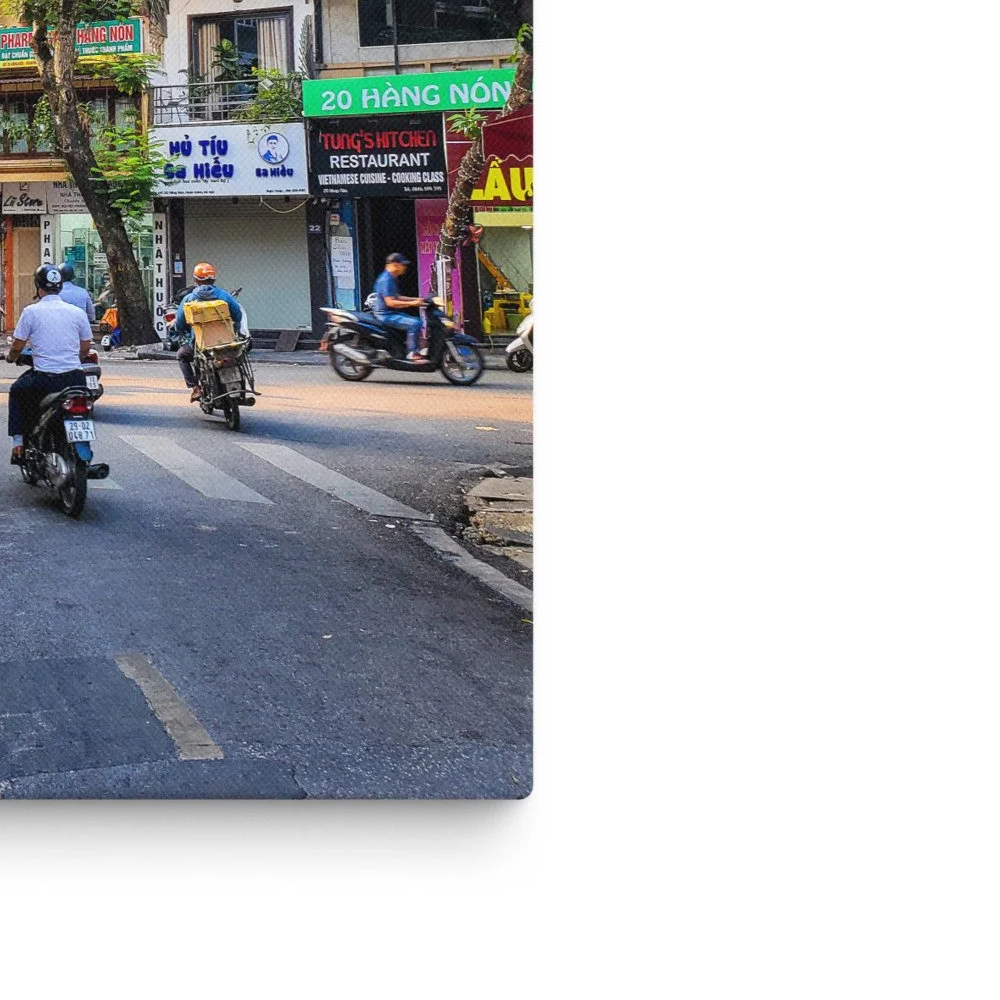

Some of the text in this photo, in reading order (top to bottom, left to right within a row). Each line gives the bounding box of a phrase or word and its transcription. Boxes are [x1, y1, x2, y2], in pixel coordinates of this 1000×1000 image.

[321, 76, 512, 111] 20 HÀNG NÓN
[169, 134, 228, 157] HỦ TÍU
[329, 153, 430, 169] RESTAURANT
[318, 173, 359, 185] VIETNAMESE
[360, 173, 386, 184] CUISINE
[392, 172, 421, 183] COOKING
[422, 171, 444, 183] CLASS
[471, 157, 533, 201] ẨU
